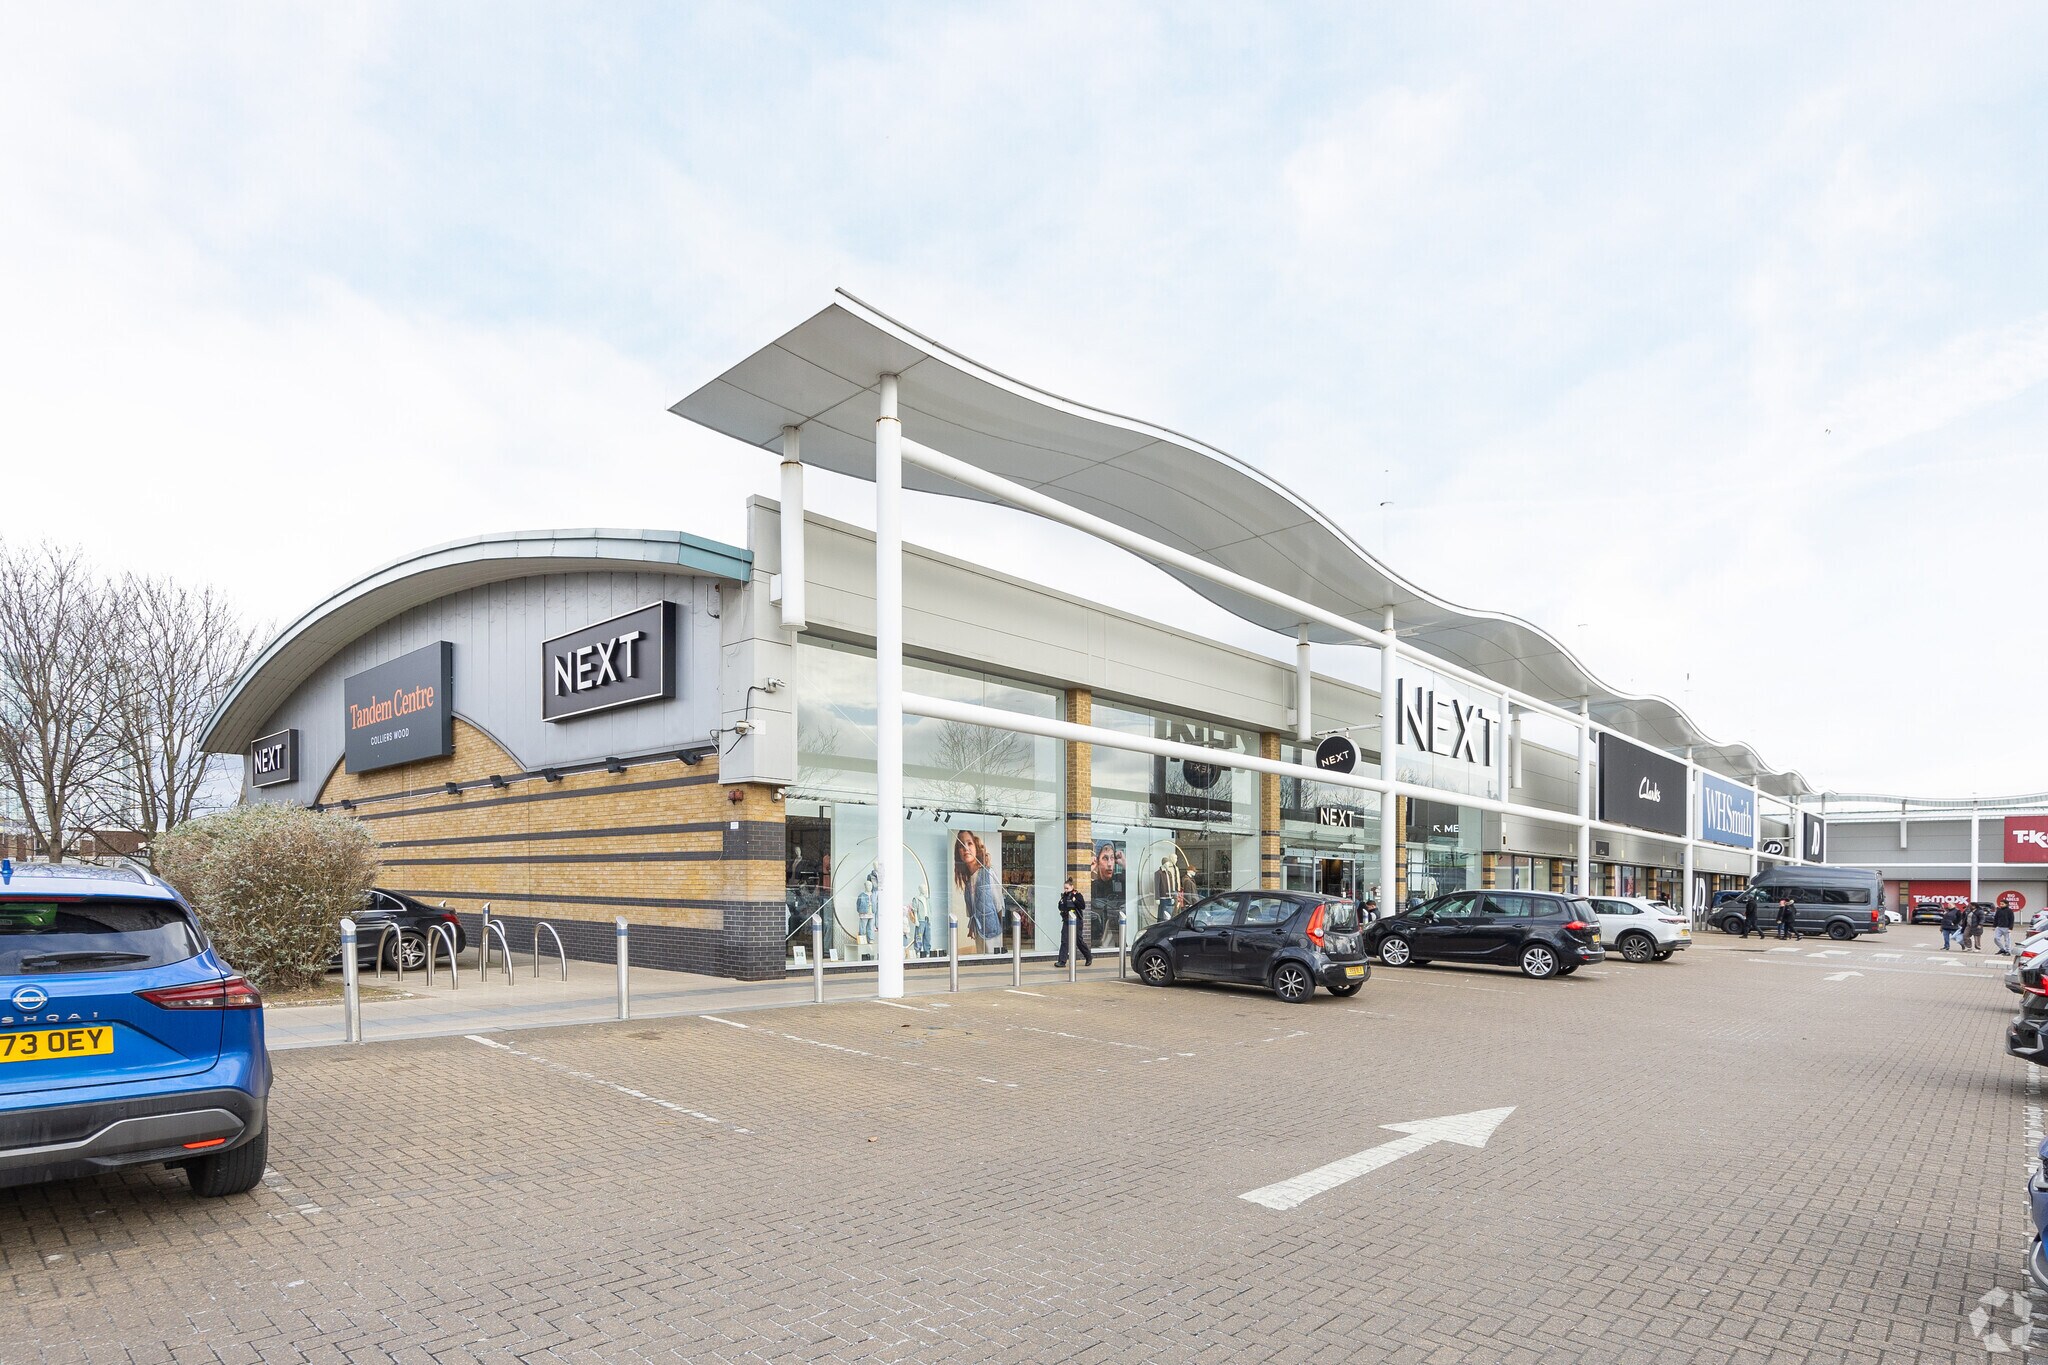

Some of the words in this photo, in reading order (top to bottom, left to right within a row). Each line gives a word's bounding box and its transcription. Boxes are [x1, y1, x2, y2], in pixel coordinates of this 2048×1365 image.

[554, 630, 640, 696] NEXT
[350, 696, 393, 730] Tandem
[393, 685, 435, 717] Centre
[1396, 677, 1500, 767] NEXT
[370, 731, 393, 746] COLLIERS
[393, 727, 410, 740] WOOD
[254, 743, 283, 775] NEXT
[1320, 750, 1350, 767] NEXT
[1638, 776, 1661, 802] Clarks
[1320, 806, 1355, 828] NEXT
[1705, 787, 1752, 838] WHSmith
[1764, 843, 1781, 854] JD
[1811, 821, 1821, 856] JD
[48, 1029, 103, 1052] OEY
